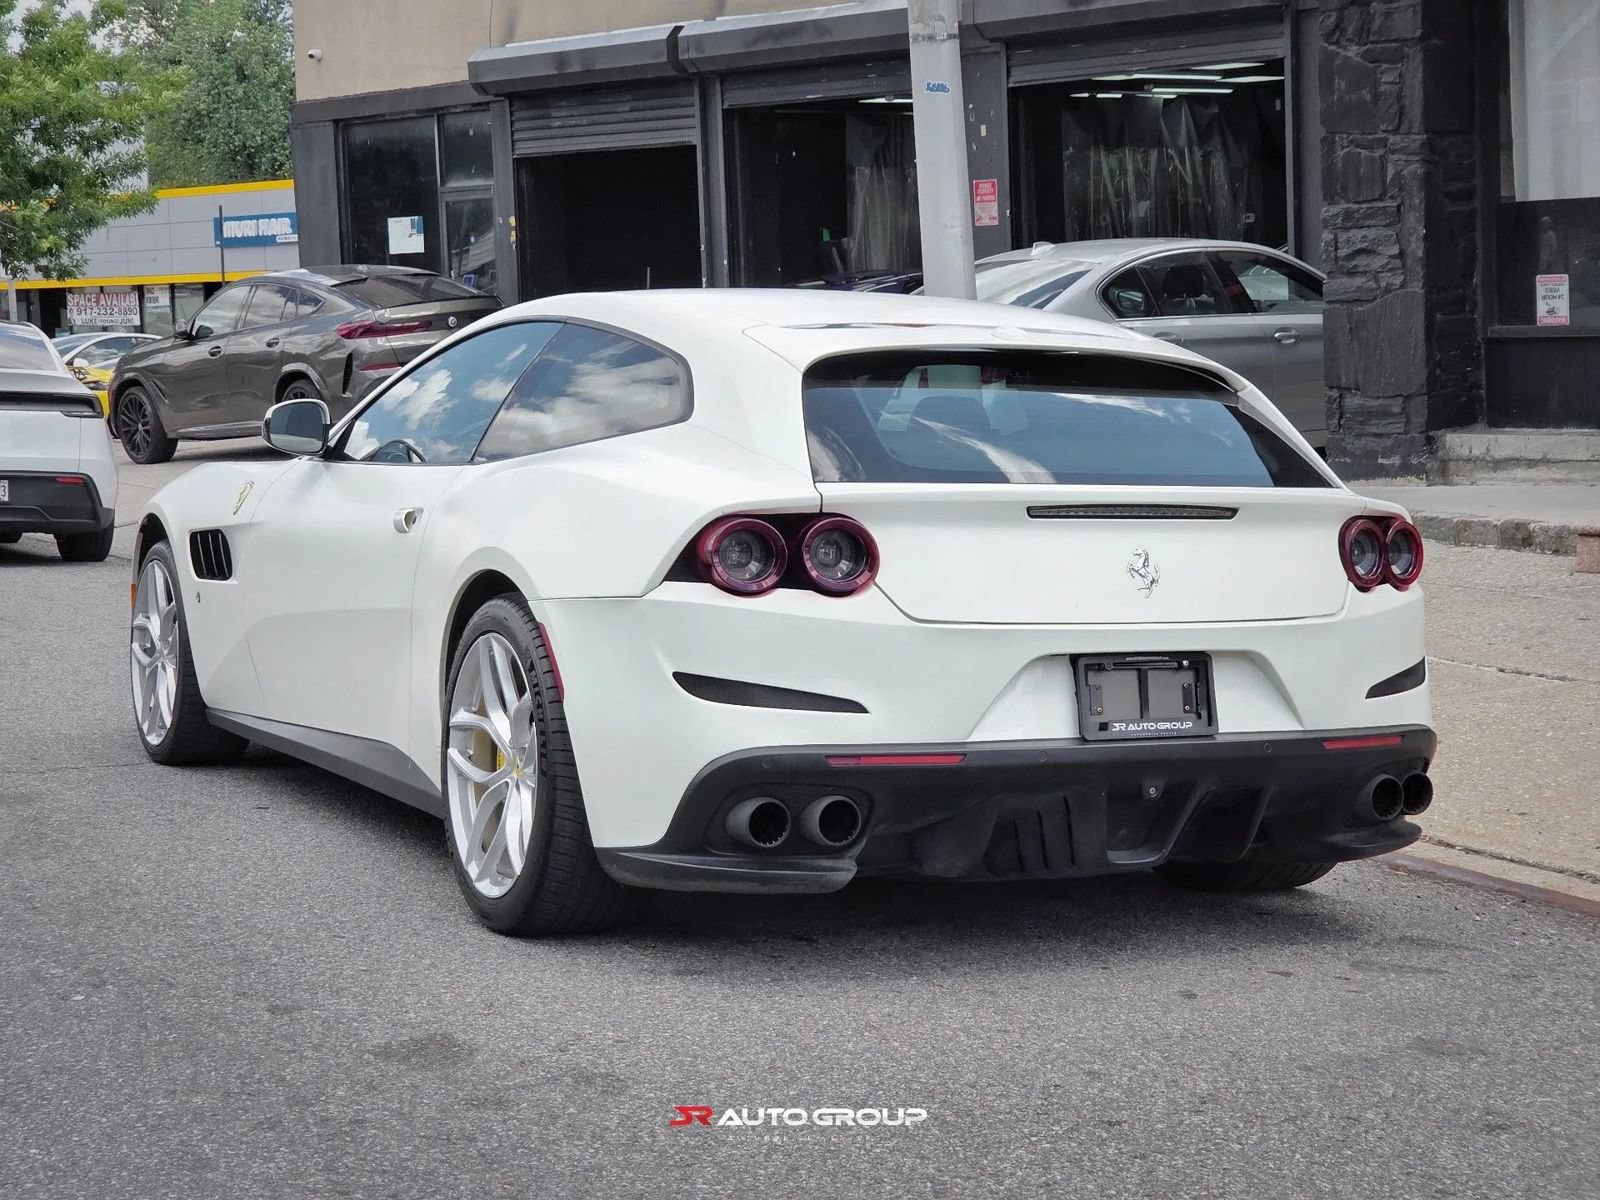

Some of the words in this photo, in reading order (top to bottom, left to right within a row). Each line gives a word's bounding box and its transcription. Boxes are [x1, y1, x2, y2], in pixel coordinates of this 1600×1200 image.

[67, 293, 97, 307] SPACE
[1127, 722, 1157, 730] AUTO
[1157, 721, 1193, 730] GROUP
